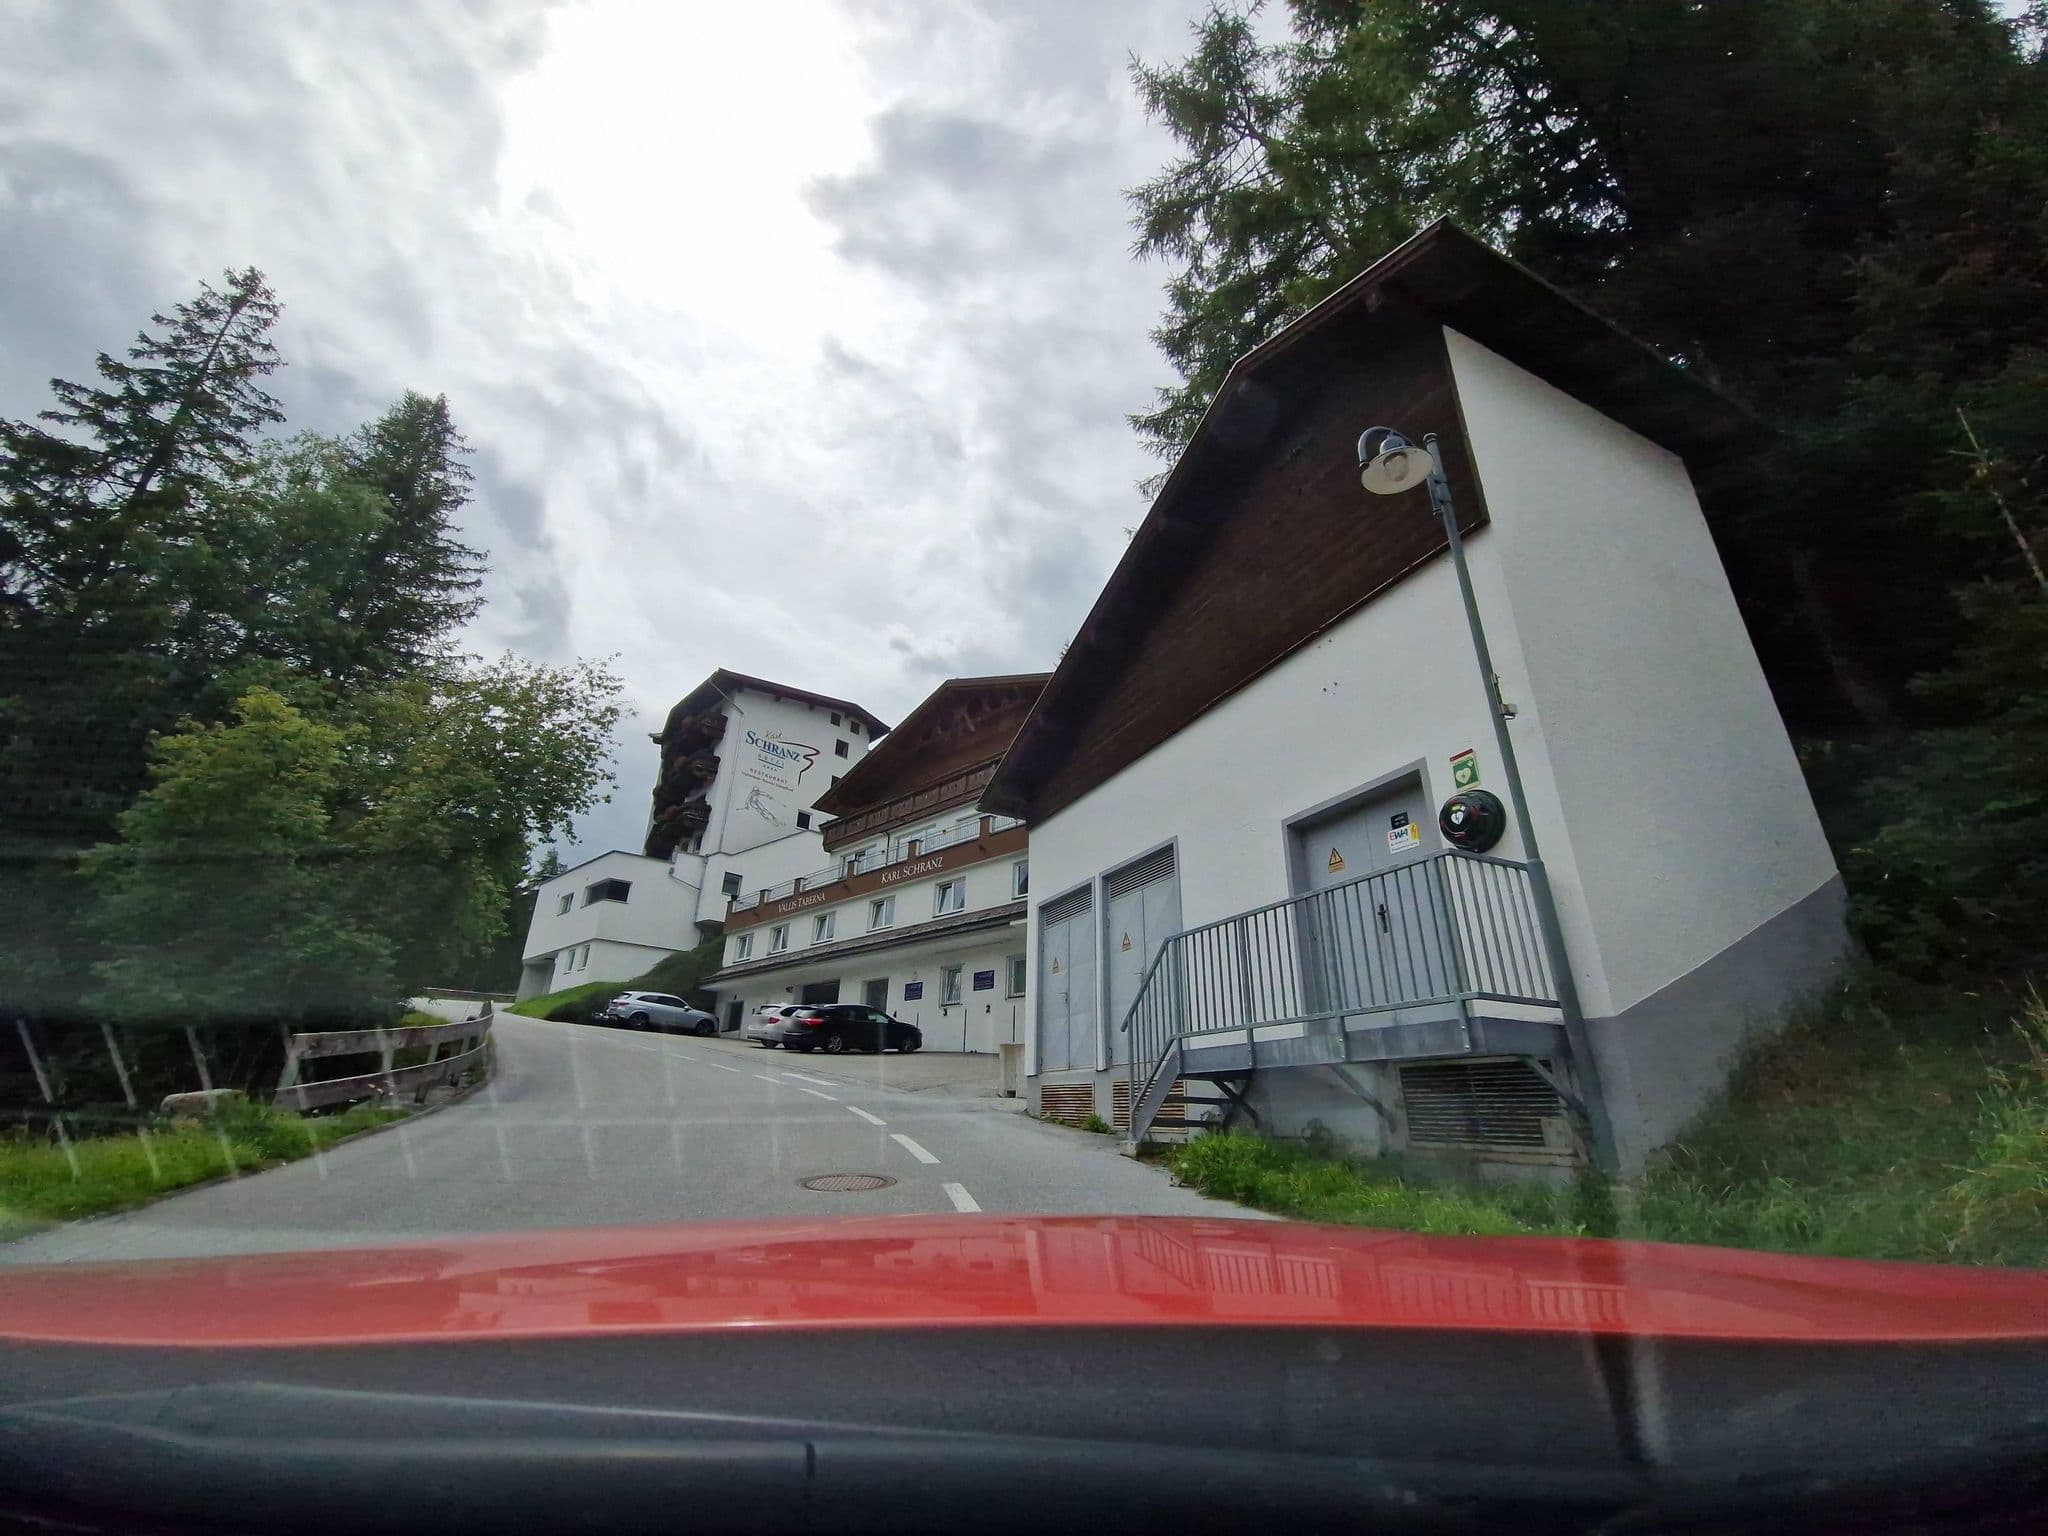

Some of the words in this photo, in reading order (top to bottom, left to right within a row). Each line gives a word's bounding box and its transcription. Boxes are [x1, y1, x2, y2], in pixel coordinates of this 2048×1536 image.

[745, 731, 800, 762] SCHRANZ
[749, 768, 788, 784] RESTAURANT
[881, 871, 901, 884] KARL
[903, 857, 943, 878] SCHRANZ
[798, 892, 826, 908] TABERNA
[985, 1004, 991, 1014] 2
